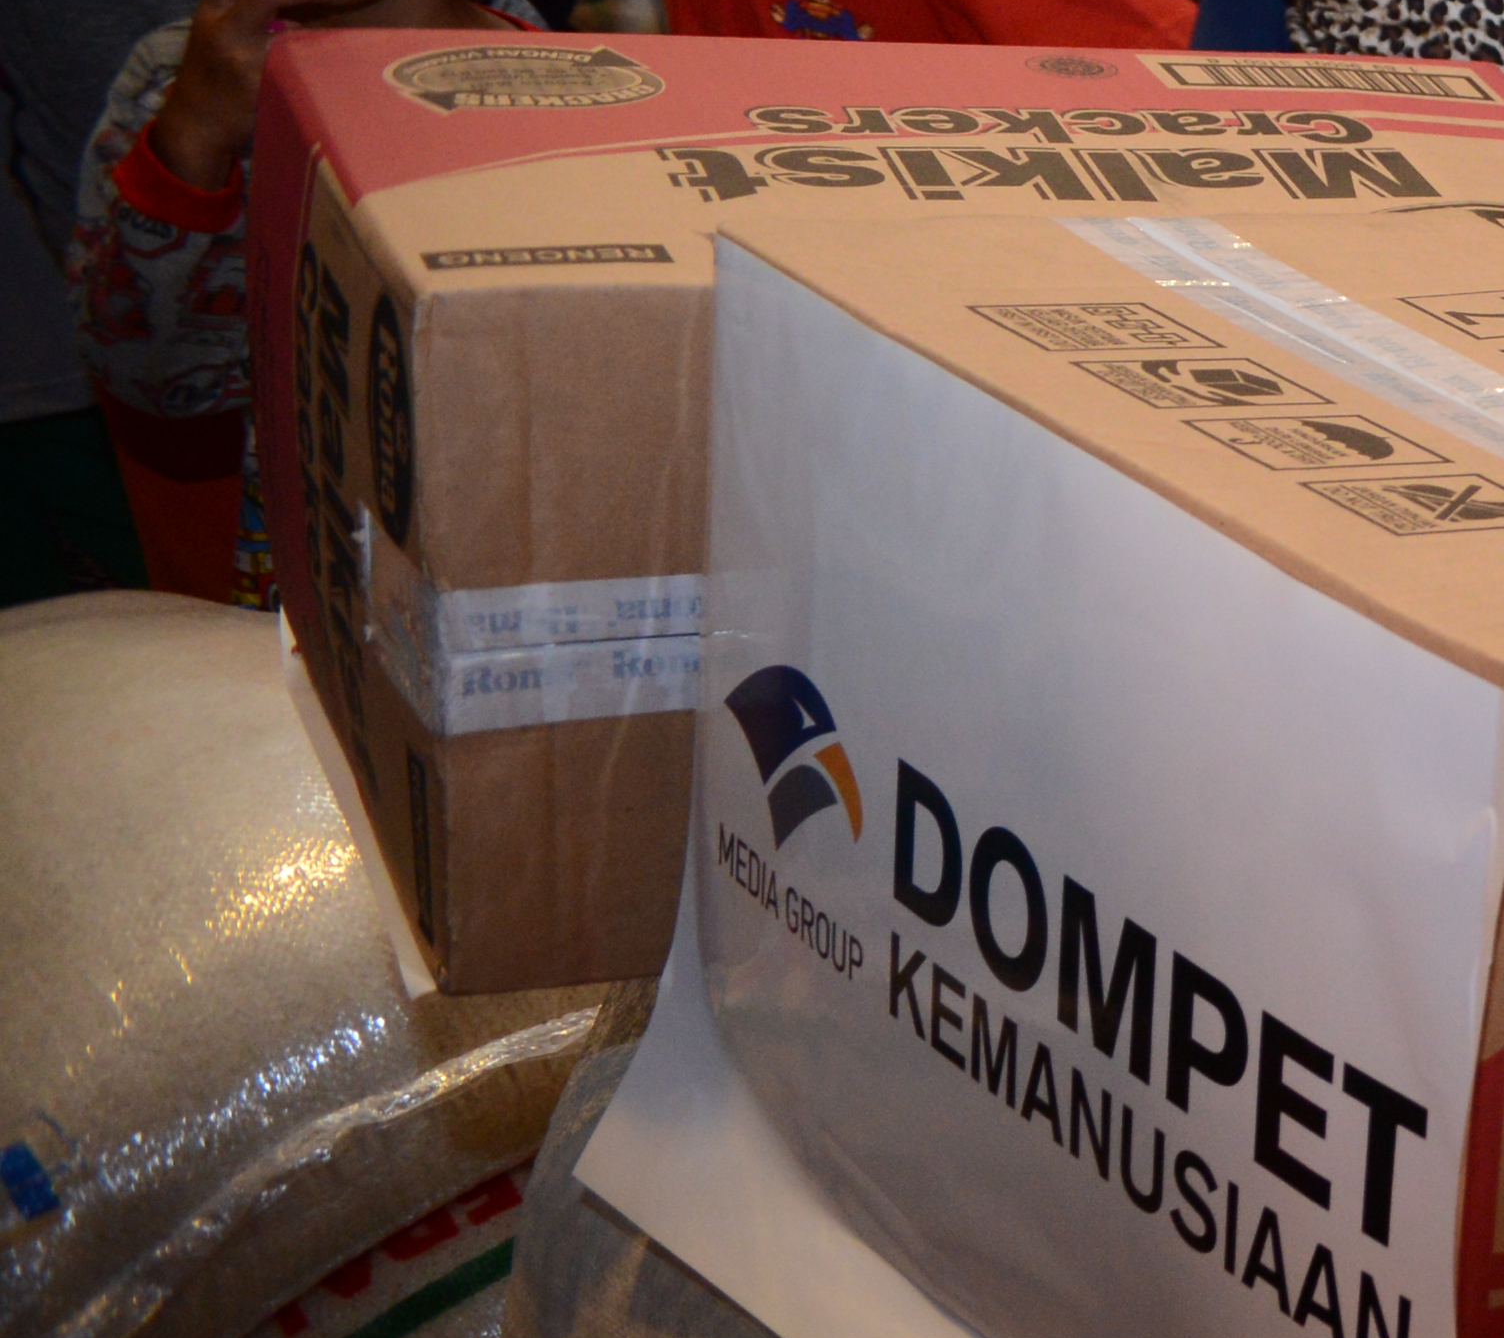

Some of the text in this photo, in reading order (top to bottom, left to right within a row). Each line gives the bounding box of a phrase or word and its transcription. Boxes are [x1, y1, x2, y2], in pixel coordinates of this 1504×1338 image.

[657, 145, 1443, 202] Malkist
[746, 106, 1373, 145] Crackers
[376, 321, 402, 518] Roma
[717, 822, 864, 981] MEDIA GROUP
[892, 756, 1429, 1249] DOMPET
